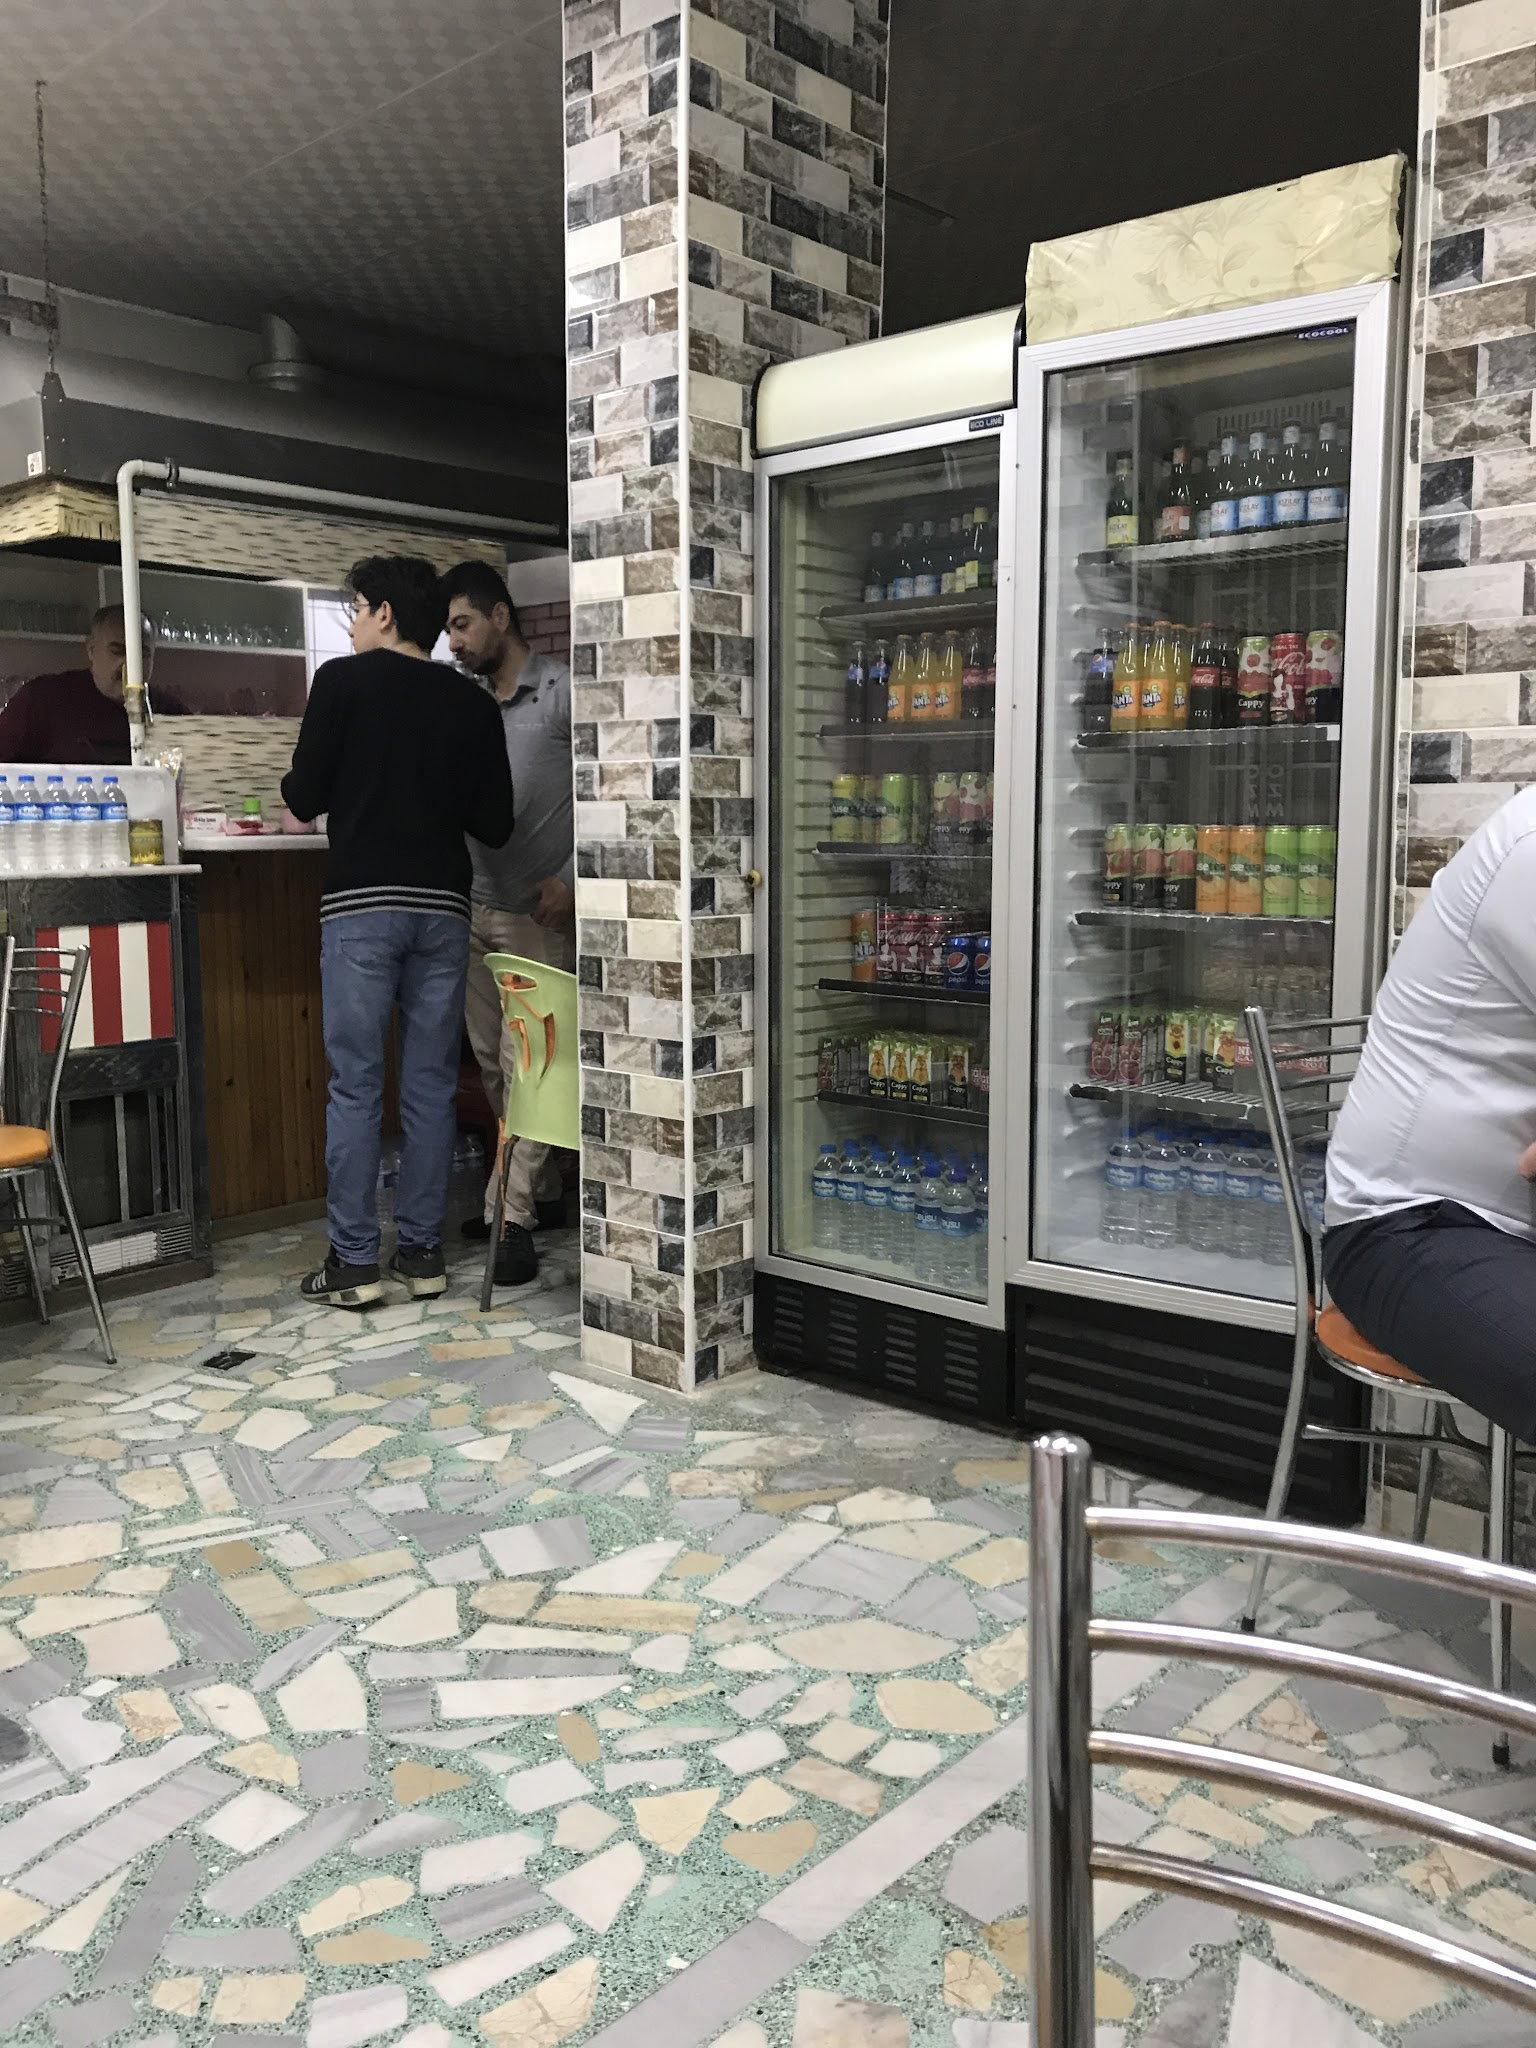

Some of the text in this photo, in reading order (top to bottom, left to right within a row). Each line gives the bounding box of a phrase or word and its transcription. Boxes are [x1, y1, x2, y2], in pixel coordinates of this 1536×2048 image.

[1298, 327, 1349, 339] ECOCOOL
[970, 415, 1003, 430] ECO LINE
[1238, 698, 1264, 709] Cappy
